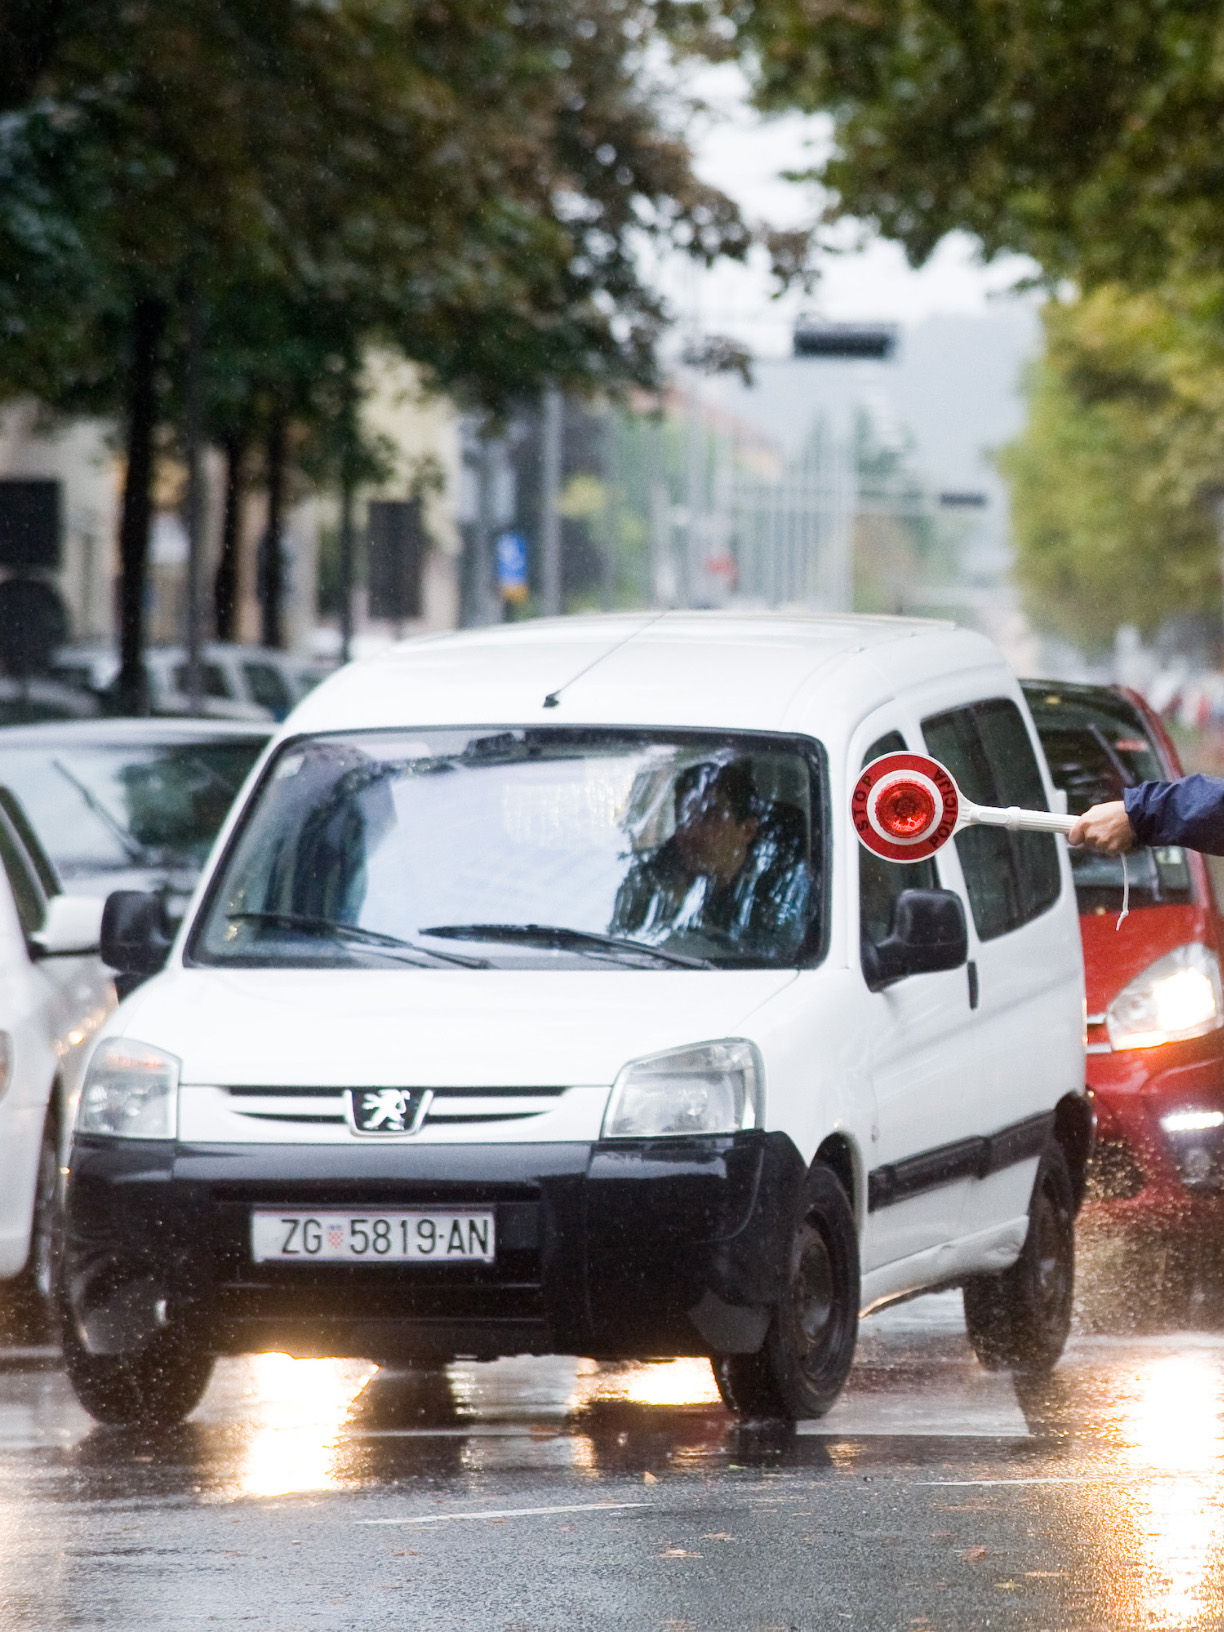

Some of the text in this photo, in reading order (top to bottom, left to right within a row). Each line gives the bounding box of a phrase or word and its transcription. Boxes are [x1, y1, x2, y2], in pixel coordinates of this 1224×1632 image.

[853, 775, 872, 832] STOP
[929, 769, 957, 848] POLICIJA
[281, 1218, 323, 1254] ZG
